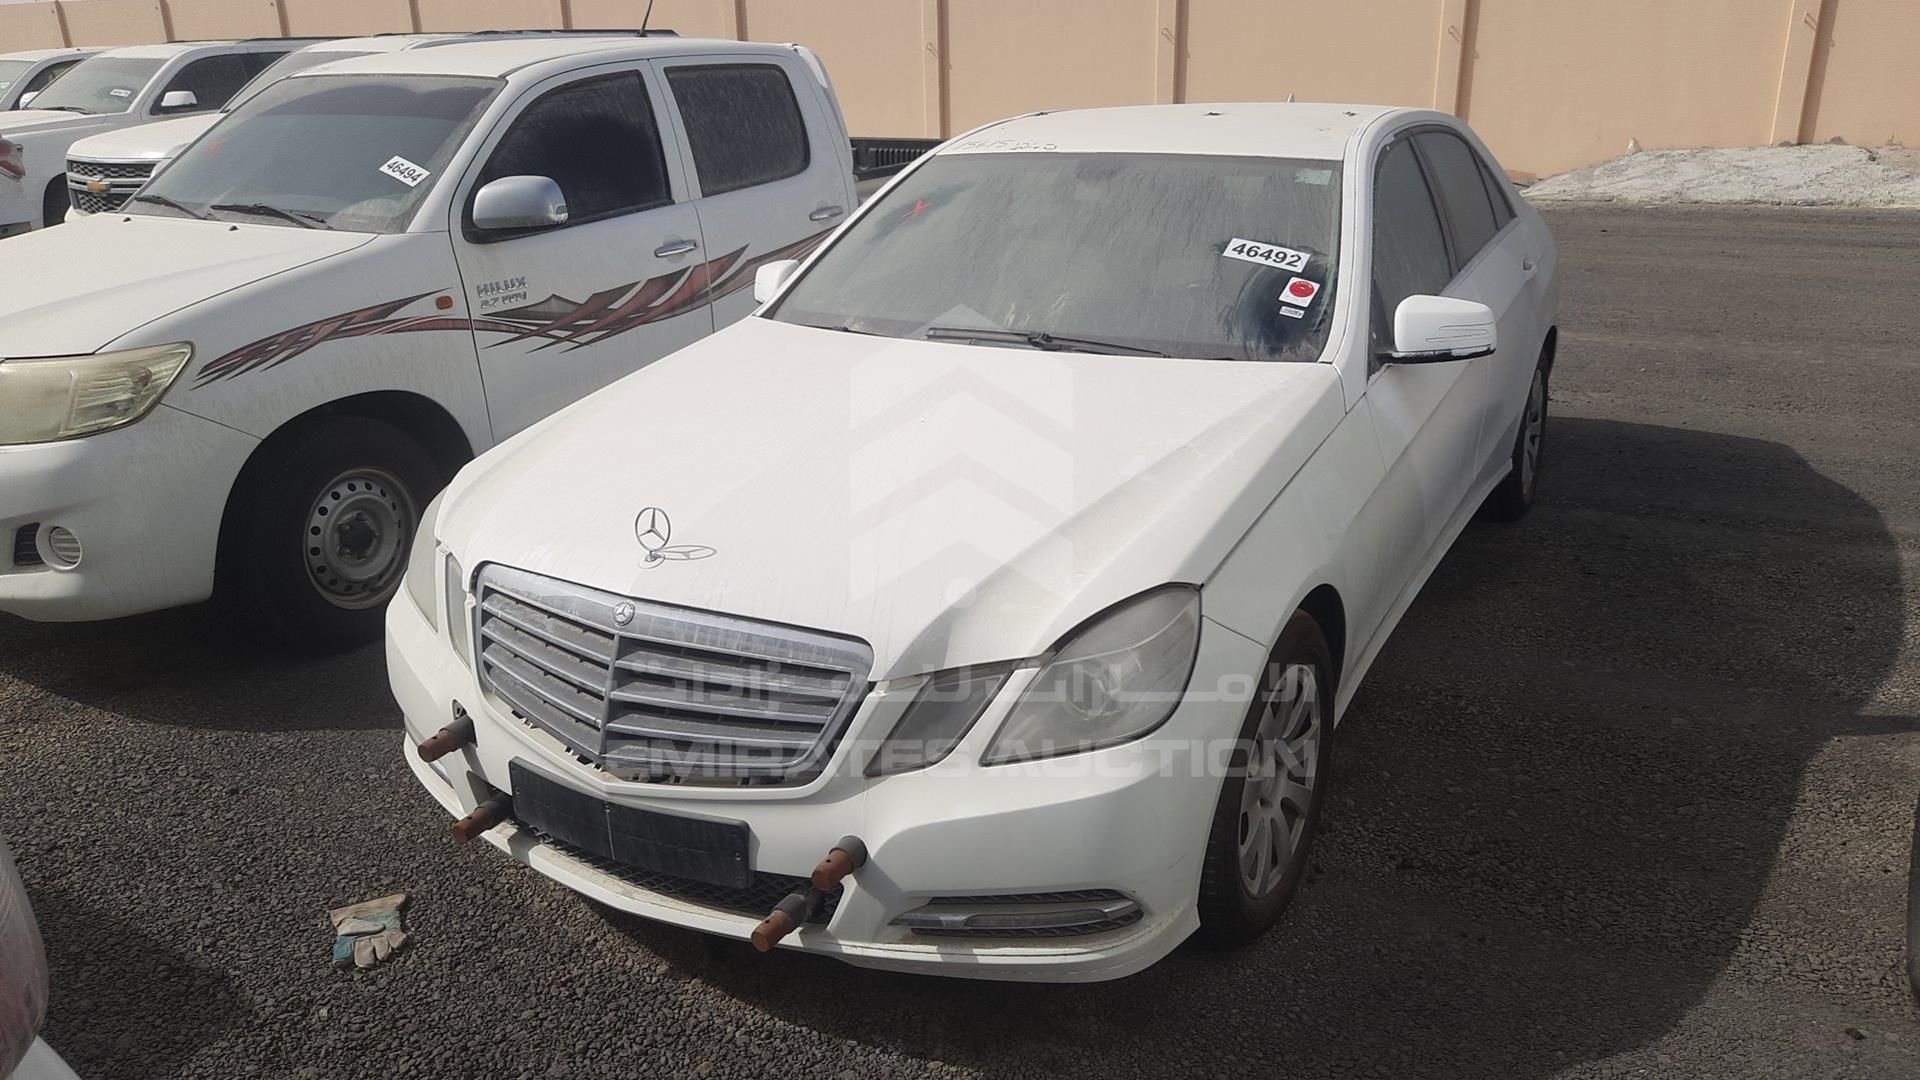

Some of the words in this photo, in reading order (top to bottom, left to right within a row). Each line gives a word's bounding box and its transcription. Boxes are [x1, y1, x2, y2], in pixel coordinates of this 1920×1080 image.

[386, 160, 424, 183] 46494
[1232, 243, 1302, 268] 46492
[476, 276, 528, 299] HILUX
